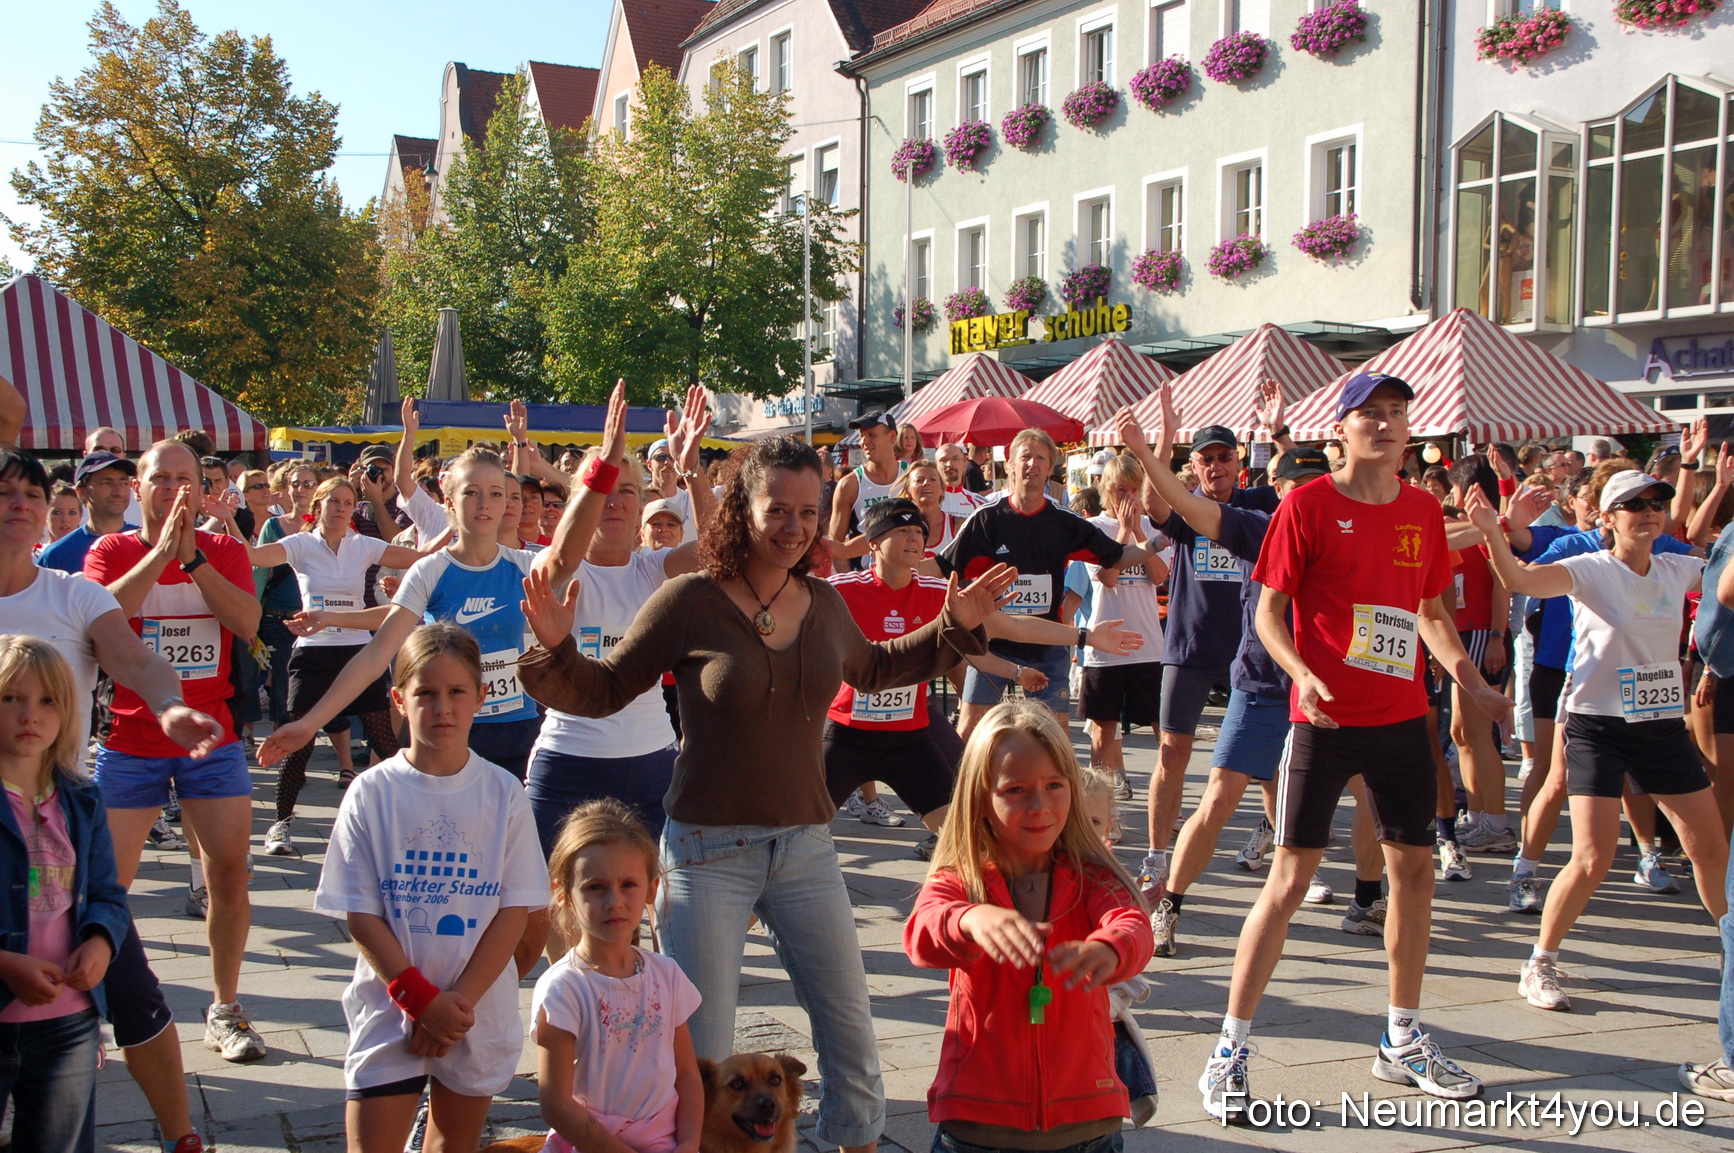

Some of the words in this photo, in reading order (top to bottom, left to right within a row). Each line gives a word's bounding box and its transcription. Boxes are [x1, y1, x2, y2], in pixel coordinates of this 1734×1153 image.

[950, 308, 1030, 355] mayer
[1043, 296, 1131, 342] schuhe
[1210, 556, 1238, 569] 327
[1014, 578, 1032, 586] Hans
[325, 599, 354, 607] Susanne
[1015, 591, 1047, 604] 2431
[463, 597, 495, 612] NIKE
[1375, 611, 1414, 632] Christian
[161, 626, 191, 637] Josef
[1358, 626, 1368, 637] C
[1373, 633, 1407, 659] 315
[163, 644, 215, 663] 3263
[481, 659, 506, 673] thrin
[1636, 670, 1674, 682] Angelika
[486, 675, 517, 698] 431
[1623, 687, 1631, 697] B
[871, 691, 911, 708] 3251
[1637, 686, 1680, 705] 3235
[424, 894, 451, 905] 2006
